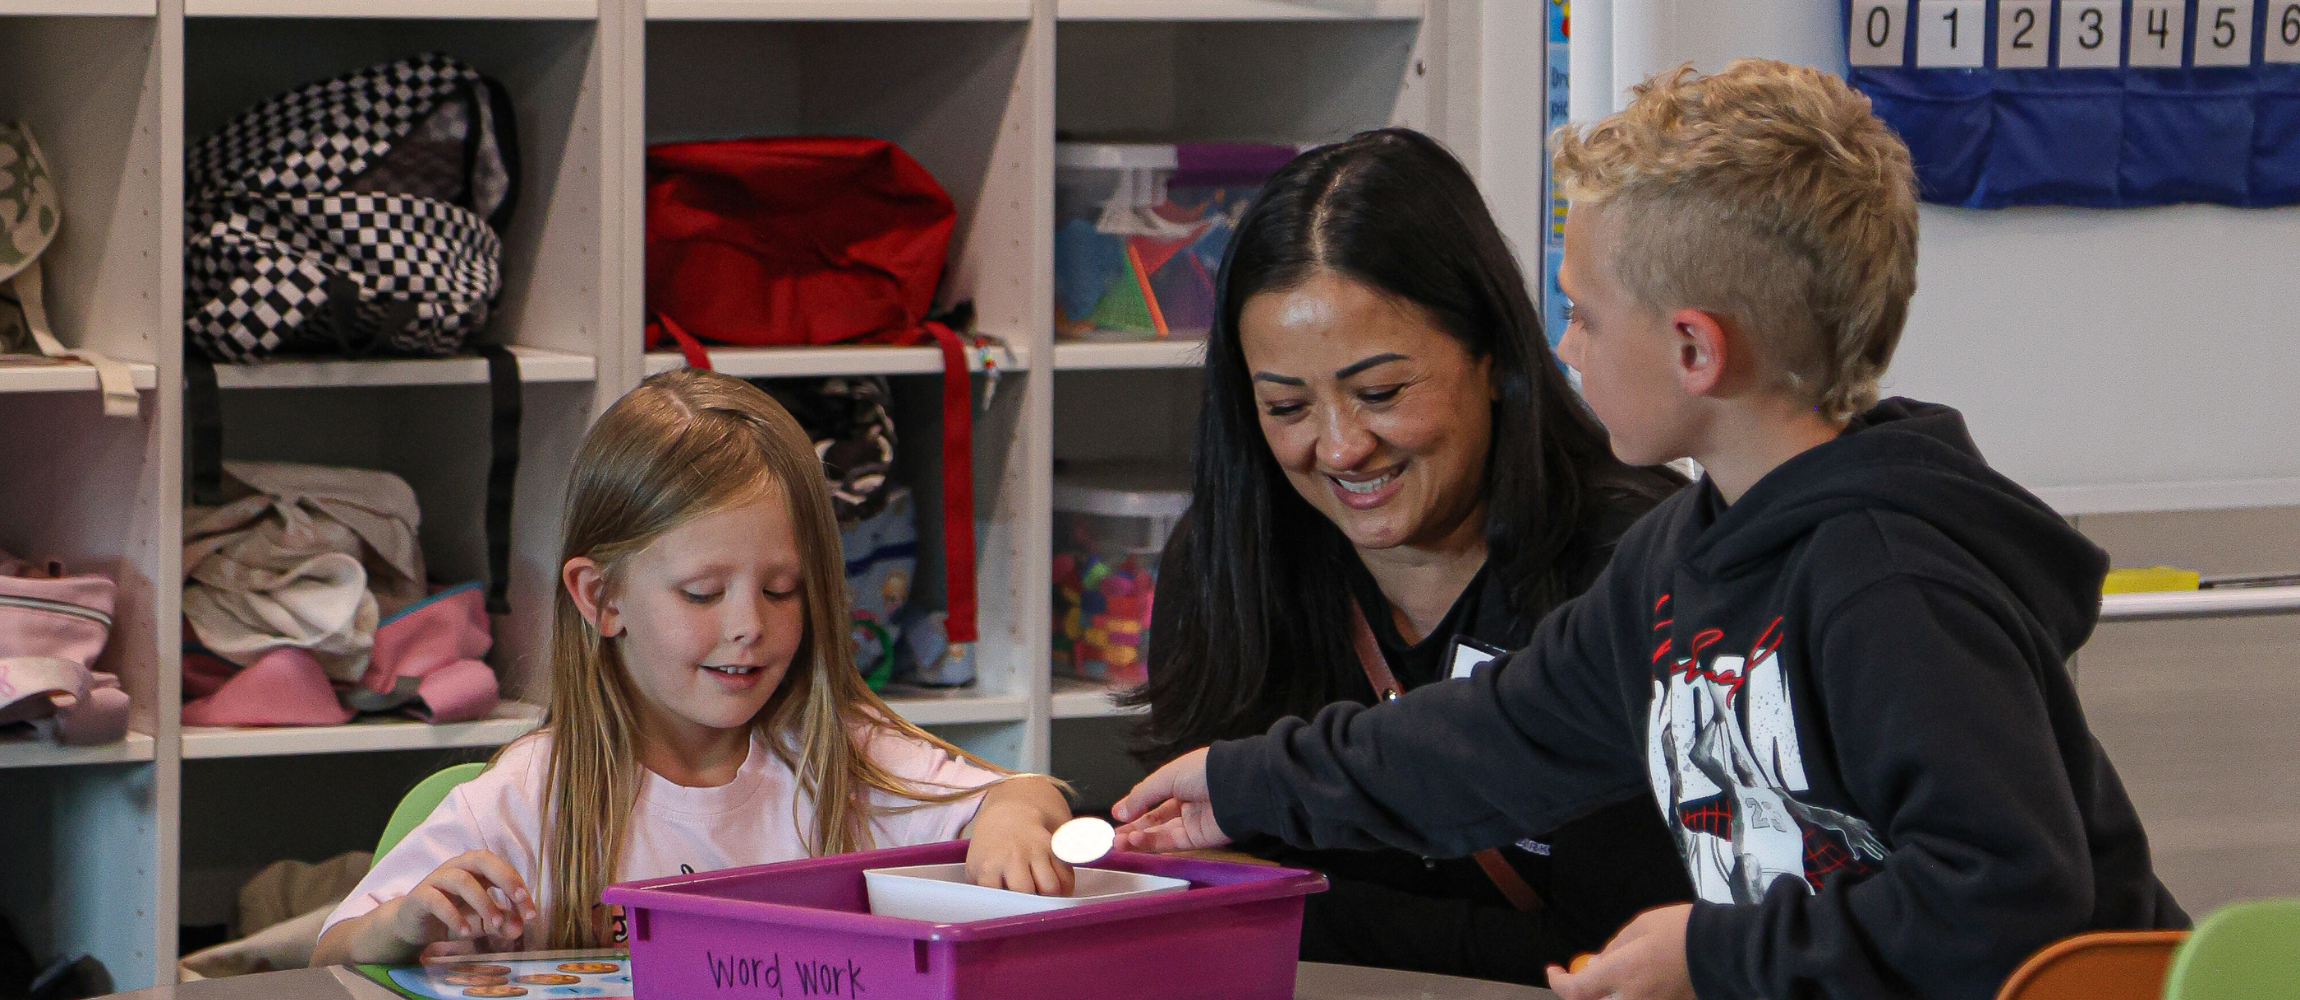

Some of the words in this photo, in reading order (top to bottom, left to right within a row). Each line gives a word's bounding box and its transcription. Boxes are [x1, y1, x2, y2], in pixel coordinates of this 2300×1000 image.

[1866, 6, 1890, 48] 0
[1943, 8, 1958, 49] 1
[2012, 8, 2035, 49] 2
[2078, 9, 2104, 50] 3
[2147, 8, 2169, 50] 4
[2213, 8, 2236, 49] 5
[2281, 4, 2300, 46] 6
